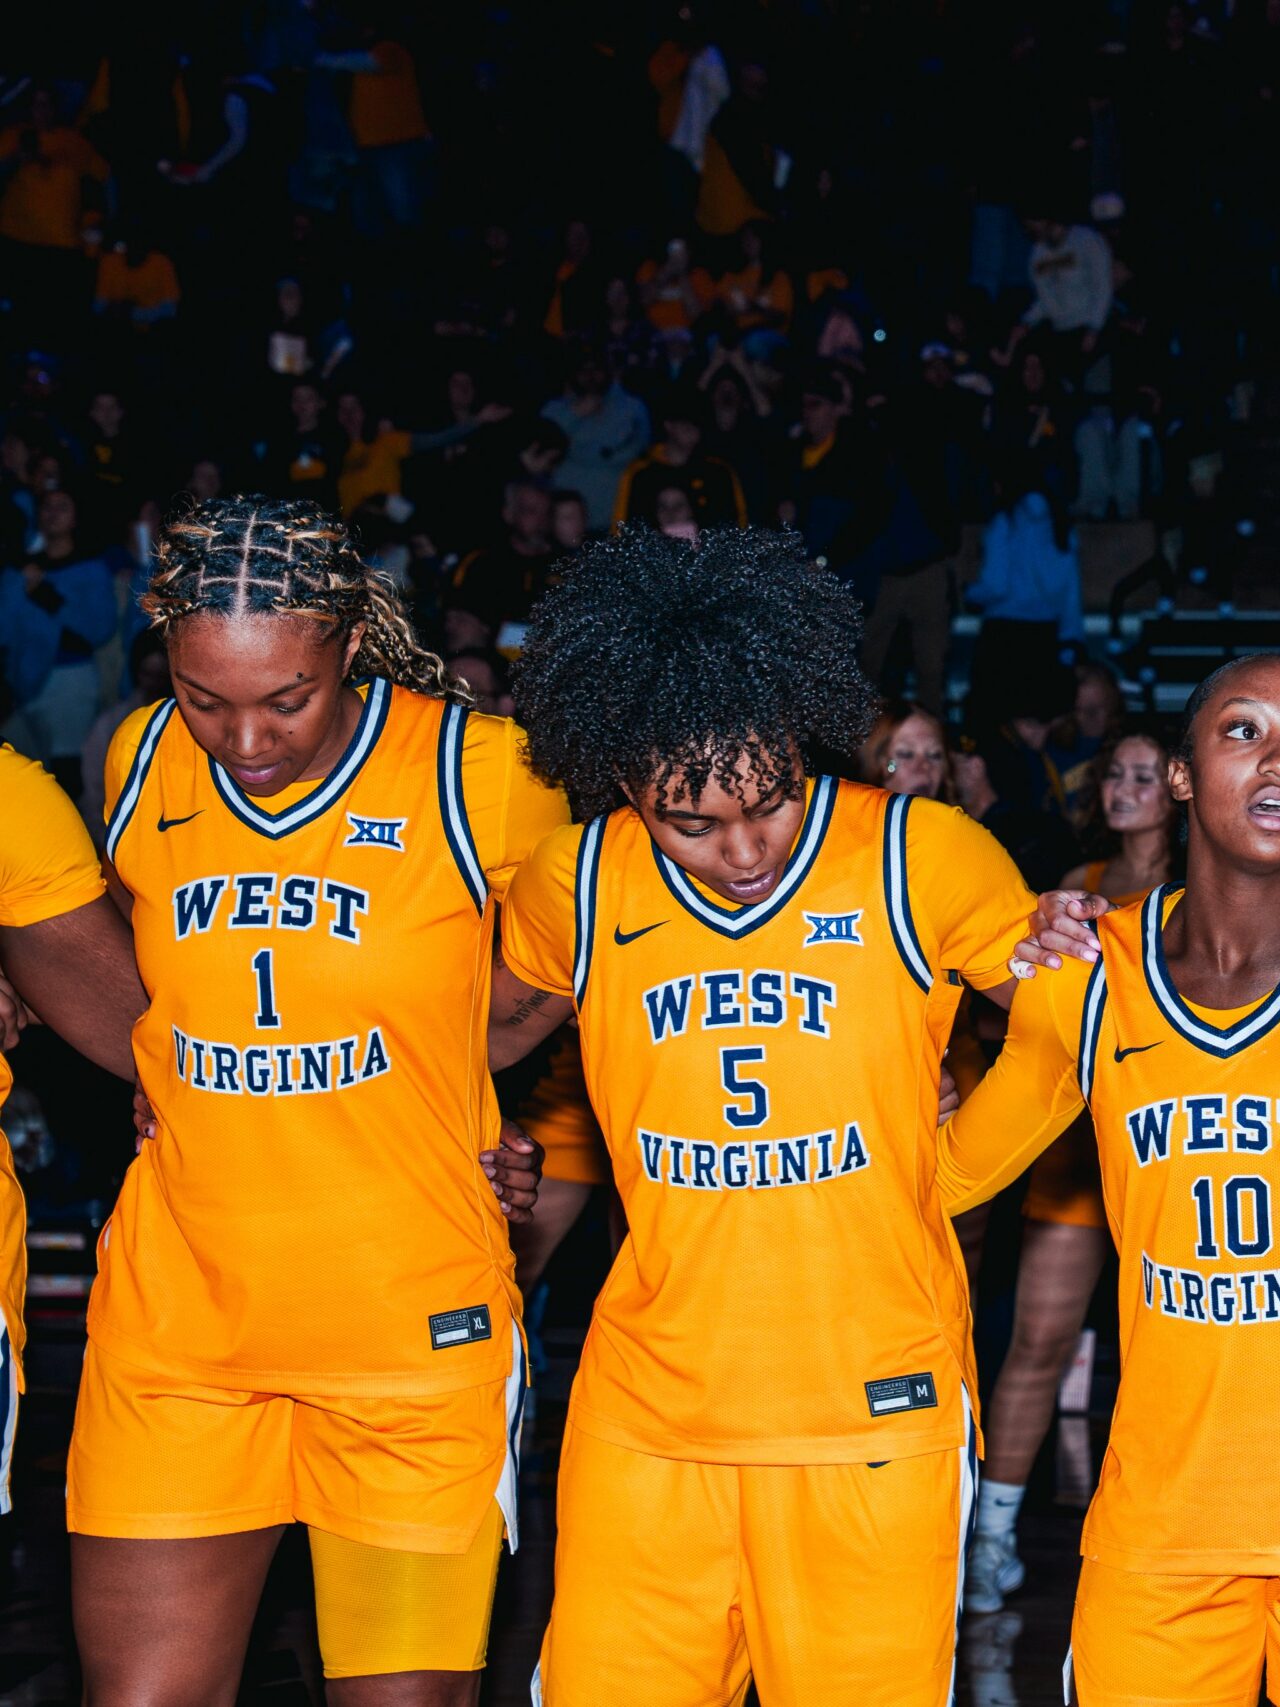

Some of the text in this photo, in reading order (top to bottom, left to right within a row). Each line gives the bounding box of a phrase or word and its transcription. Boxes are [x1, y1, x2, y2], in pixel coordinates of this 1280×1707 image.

[344, 813, 406, 851] XII
[173, 873, 368, 944] WEST
[803, 910, 863, 947] XII
[252, 949, 281, 1028] 1
[643, 969, 836, 1043] WEST
[173, 1026, 390, 1096] VIRGINIA
[720, 1045, 769, 1128] 5
[639, 1121, 869, 1190] VIRGINIA
[1192, 1175, 1272, 1259] 10
[473, 1316, 486, 1331] XL
[915, 1384, 929, 1398] M
